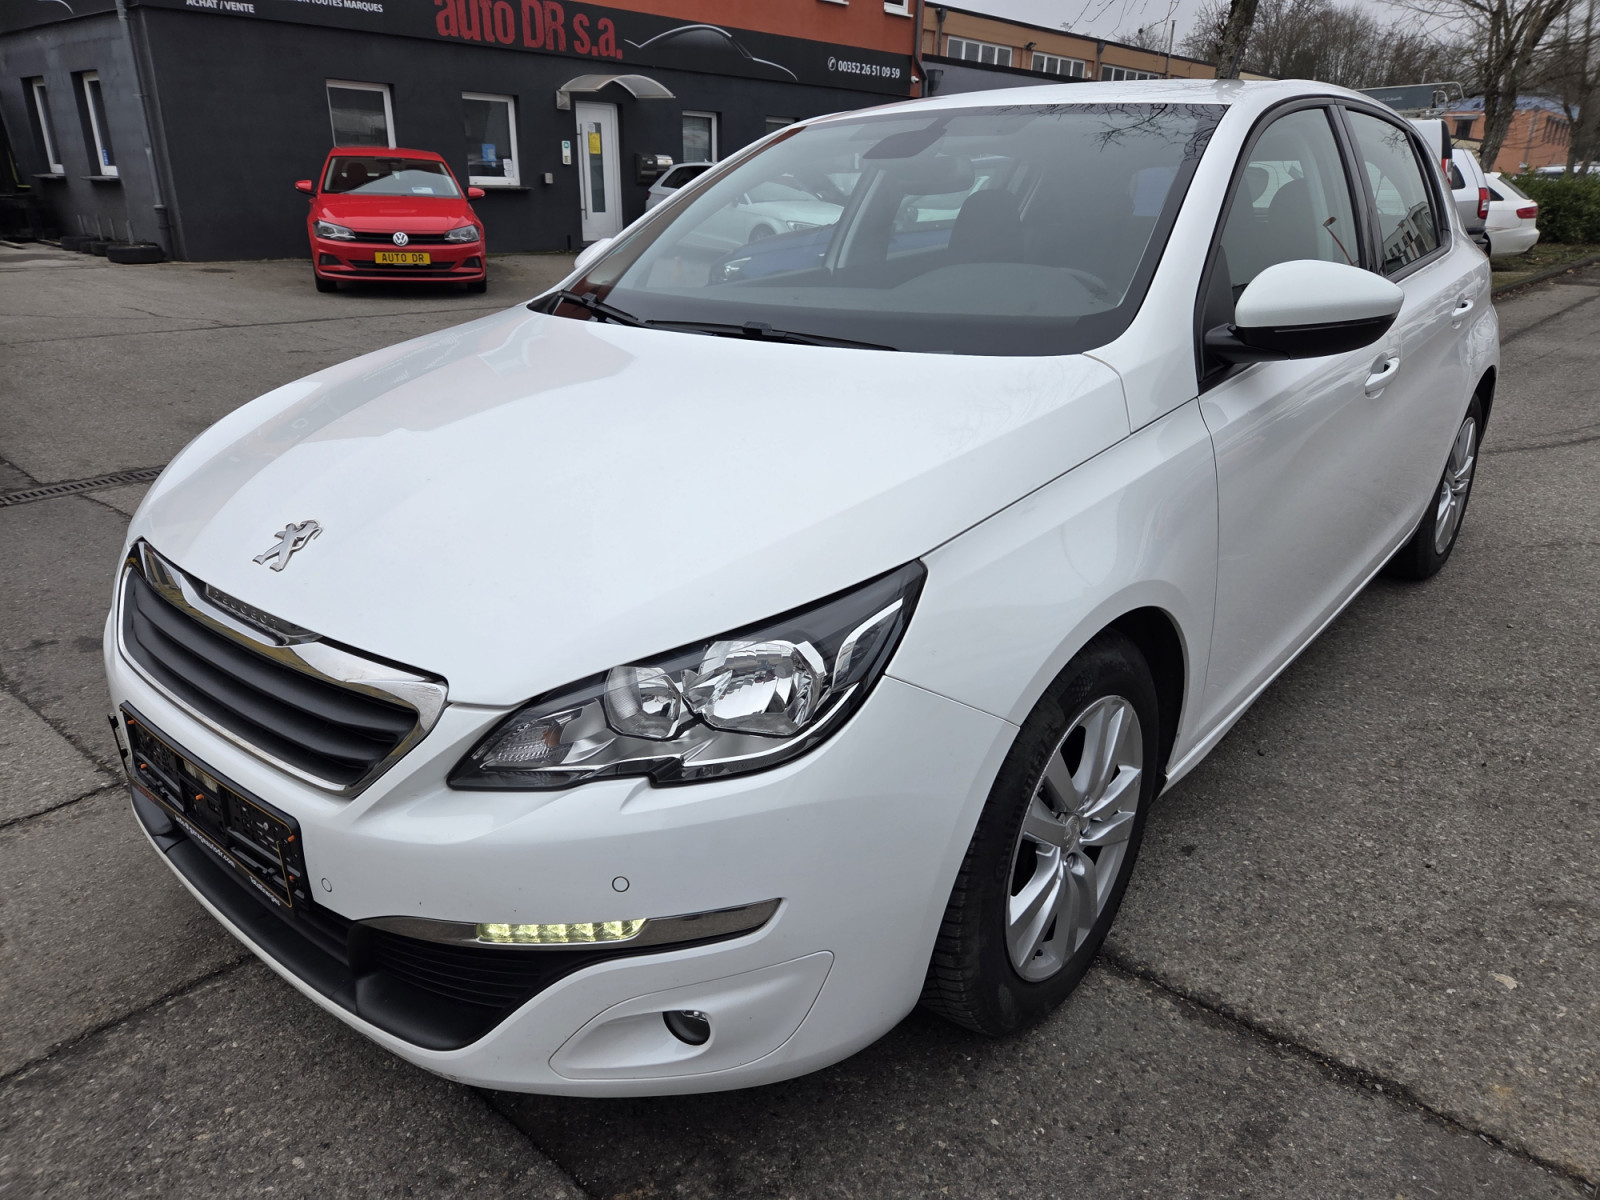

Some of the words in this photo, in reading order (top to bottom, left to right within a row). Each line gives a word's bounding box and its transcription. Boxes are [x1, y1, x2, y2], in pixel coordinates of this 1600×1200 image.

[224, 1, 255, 14] VENTE
[344, 0, 384, 13] MARQUES
[434, 0, 515, 44] auto
[521, 0, 567, 51] DR
[572, 13, 624, 60] s.a.
[838, 60, 860, 74] 00352
[861, 63, 871, 75] 26
[872, 65, 880, 76] 51
[881, 66, 891, 77] 09
[891, 68, 901, 79] 59
[382, 253, 407, 262] AUTO
[412, 254, 425, 263] DR
